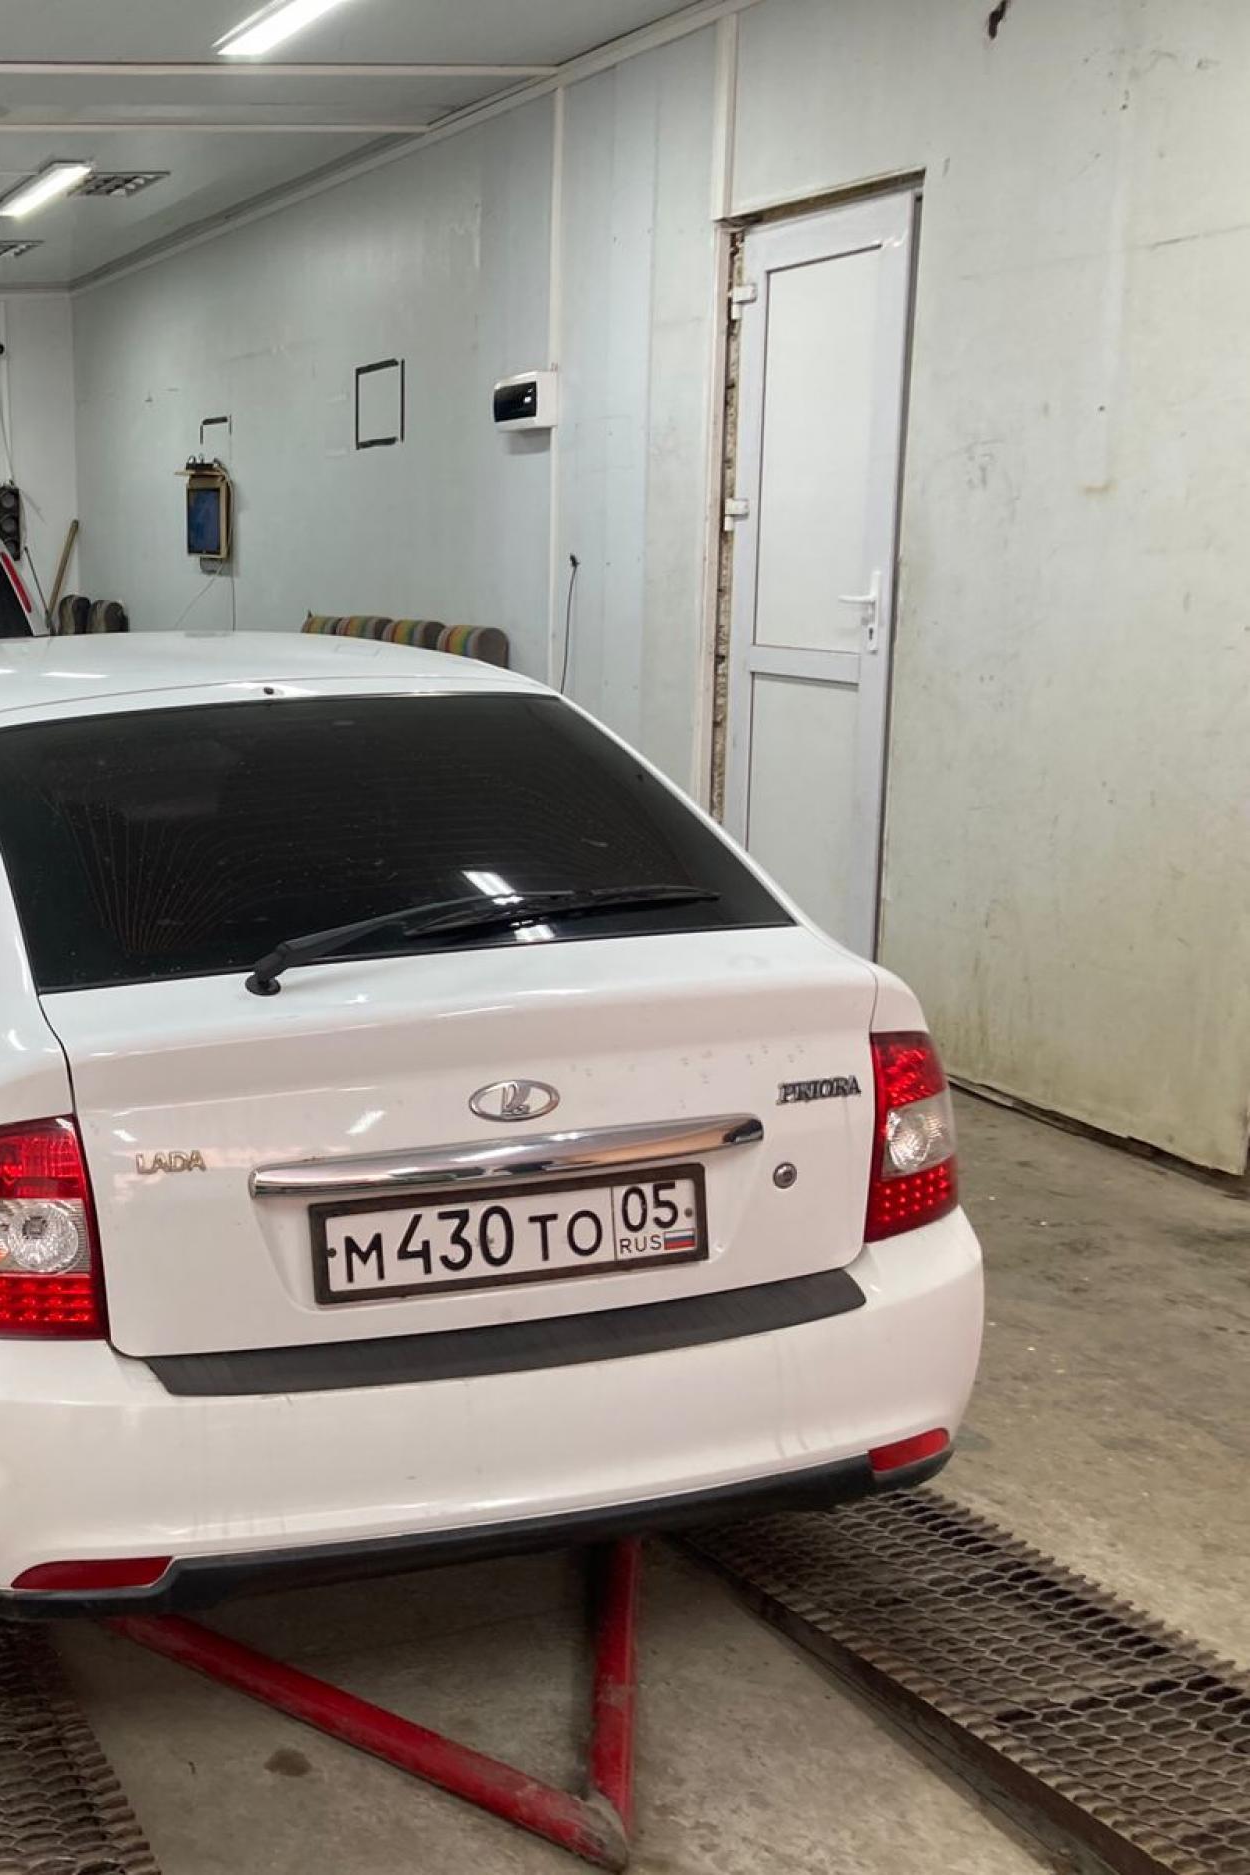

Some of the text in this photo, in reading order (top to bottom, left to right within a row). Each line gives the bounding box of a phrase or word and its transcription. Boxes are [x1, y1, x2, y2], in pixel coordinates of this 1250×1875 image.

[776, 1075, 862, 1105] PRIORA
[135, 1150, 207, 1175] LADA
[621, 1181, 680, 1233] 05
[619, 1235, 663, 1254] RUS
